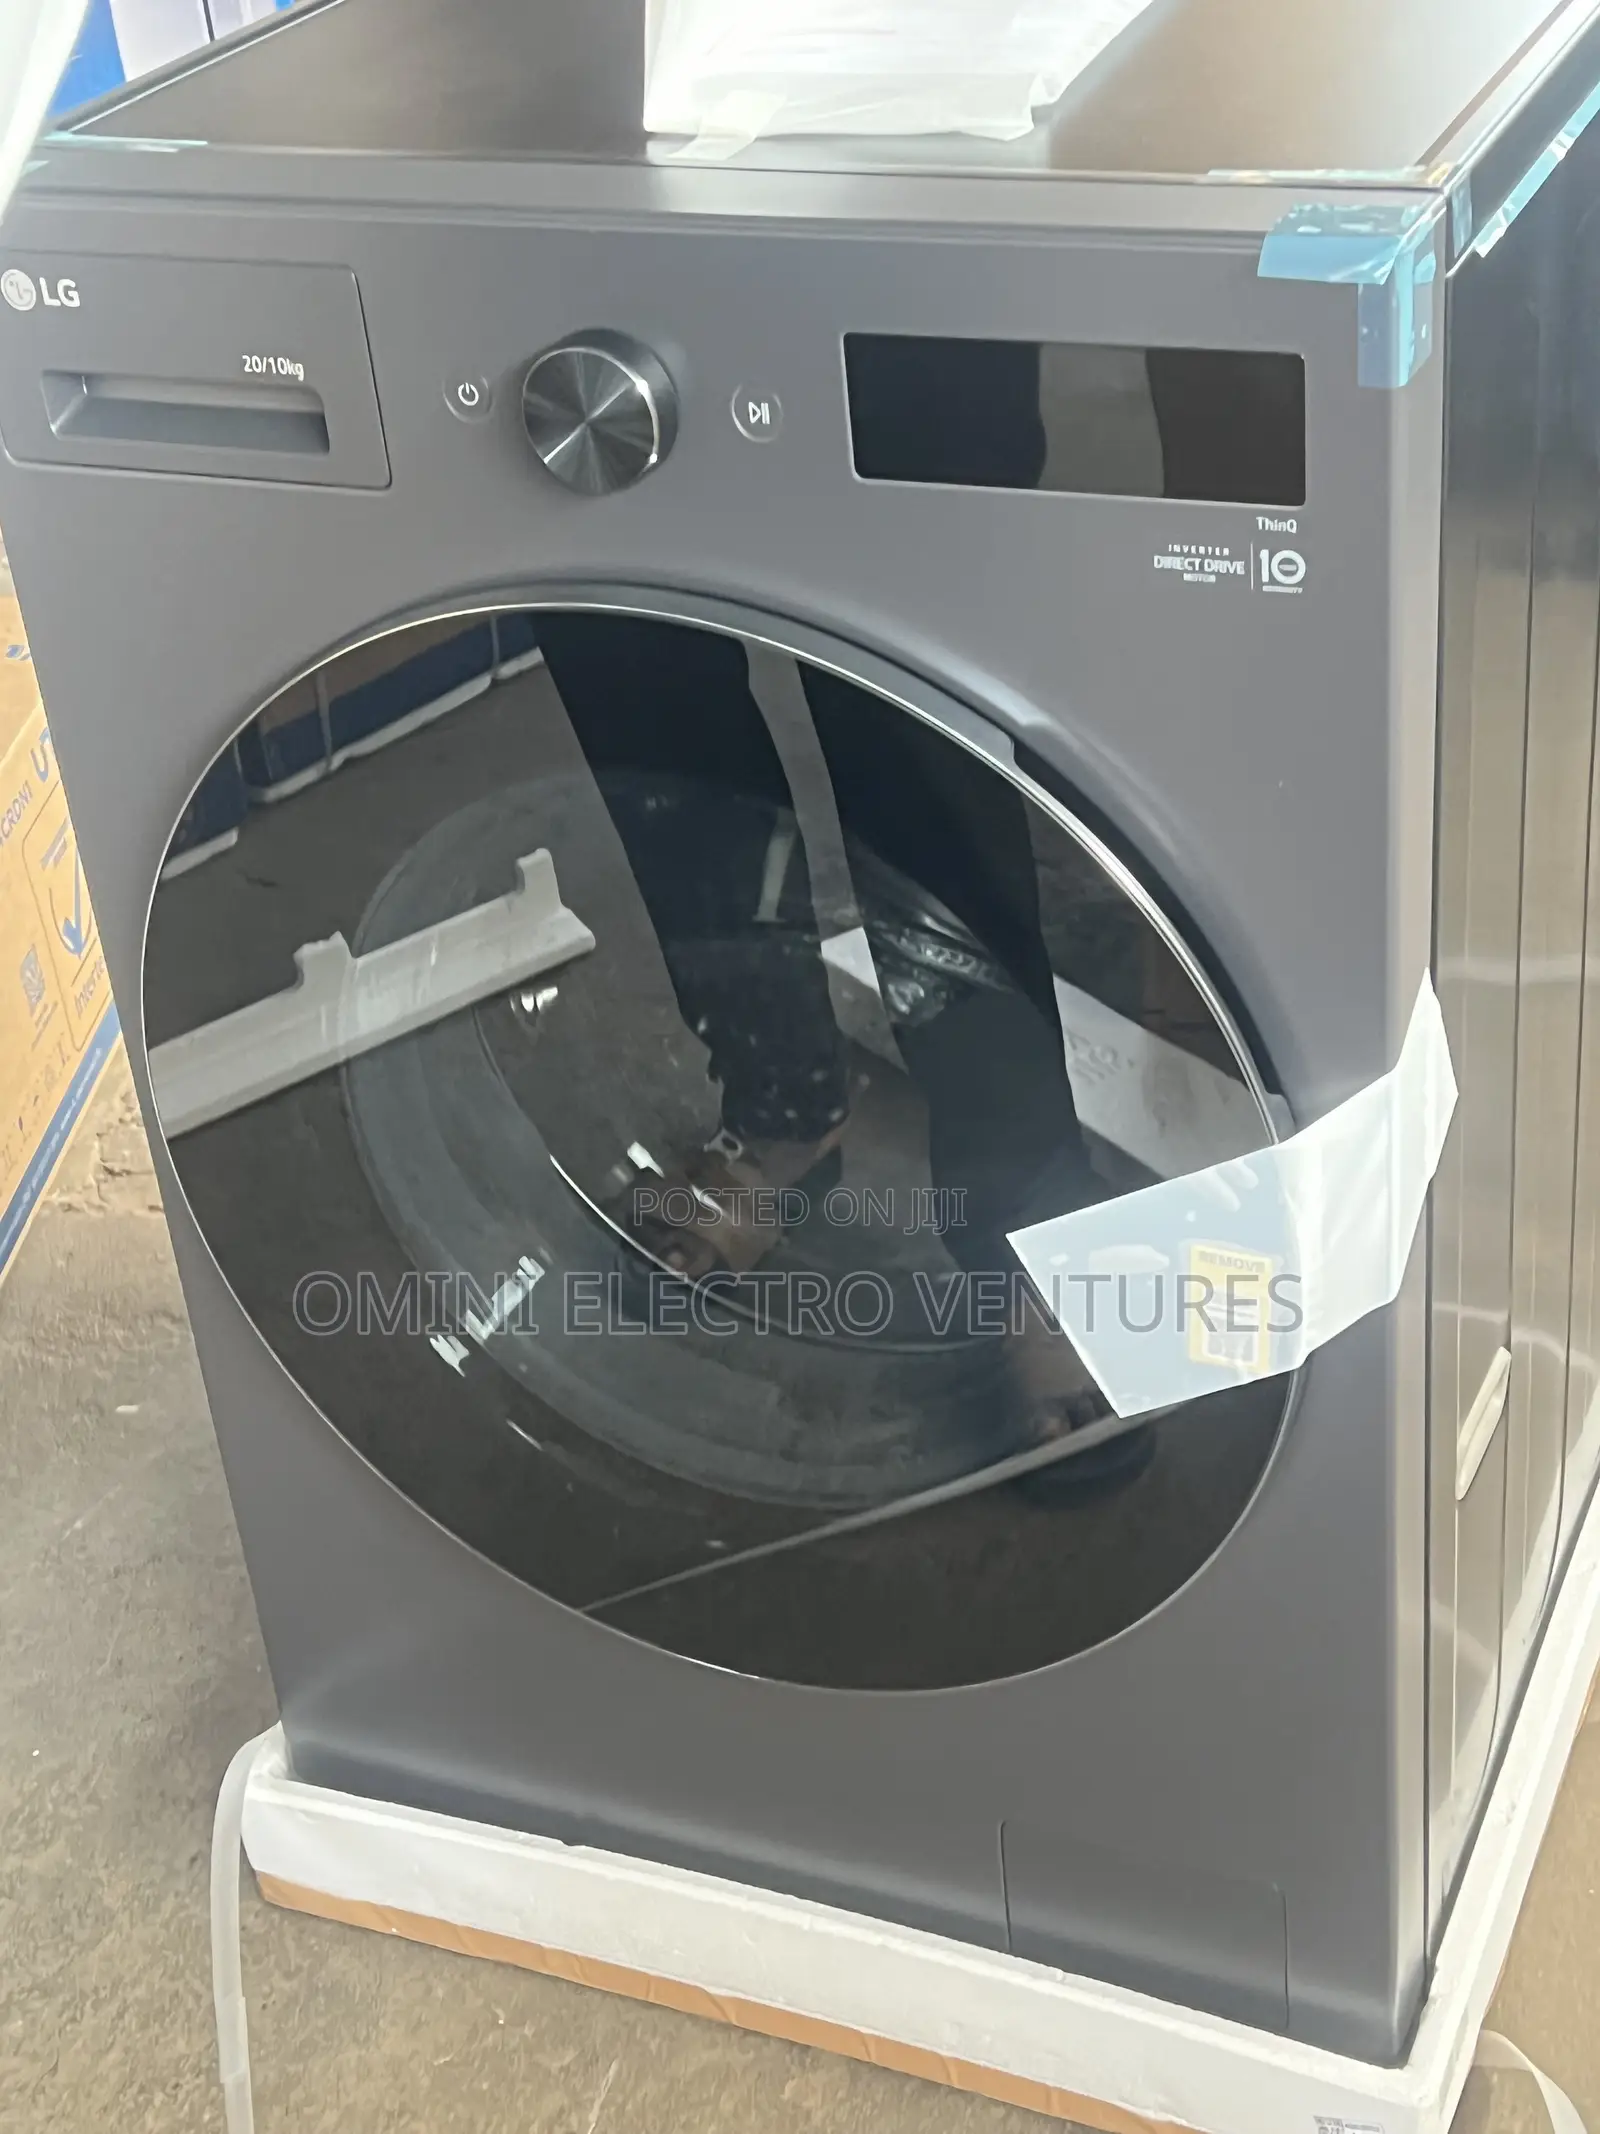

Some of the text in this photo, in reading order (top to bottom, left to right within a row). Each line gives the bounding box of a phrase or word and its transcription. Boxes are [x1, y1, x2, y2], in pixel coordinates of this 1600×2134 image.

[39, 277, 81, 308] LG
[241, 354, 305, 382] 20/10kg
[1256, 516, 1298, 534] ThinQ
[1168, 543, 1230, 556] INVERTER
[1153, 555, 1246, 575] DIRECT DRIVE
